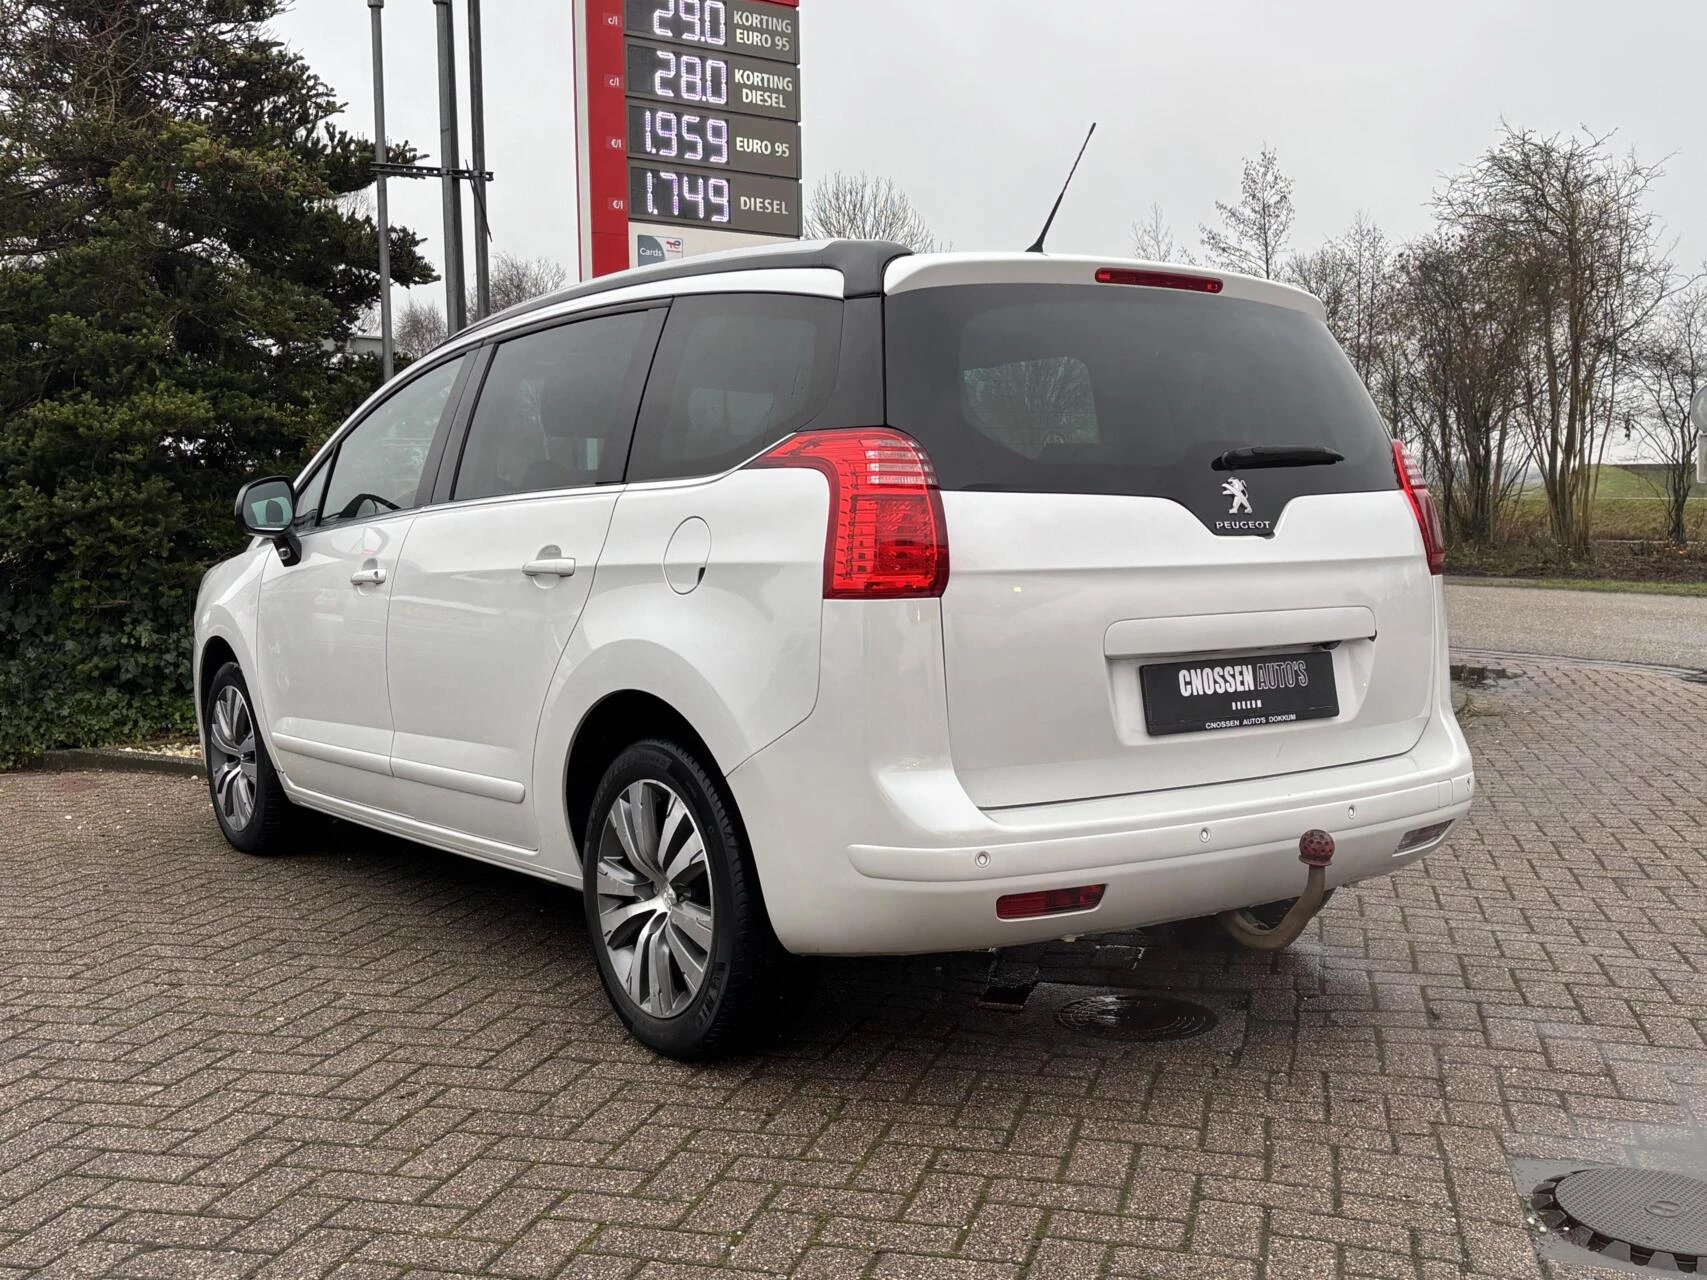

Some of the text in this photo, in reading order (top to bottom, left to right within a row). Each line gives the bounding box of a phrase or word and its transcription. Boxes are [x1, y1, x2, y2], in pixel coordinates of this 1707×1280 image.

[653, 0, 725, 45] 29.0
[733, 10, 792, 34] KORTING
[735, 28, 790, 51] EURO 95
[655, 51, 727, 104] 28.0
[734, 68, 793, 91] KORTING
[742, 88, 786, 109] DIESEL
[645, 110, 728, 163] 1.959
[735, 136, 790, 157] EURO 95
[646, 171, 729, 222] 1.749
[740, 196, 789, 215] DIESEL
[639, 247, 662, 257] Cards
[1215, 521, 1271, 529] PEUGEOT
[1178, 660, 1309, 697] CNOSSEN AUTO'S
[1205, 713, 1296, 729] CNOSSEN AUTO'S DOKKUM
